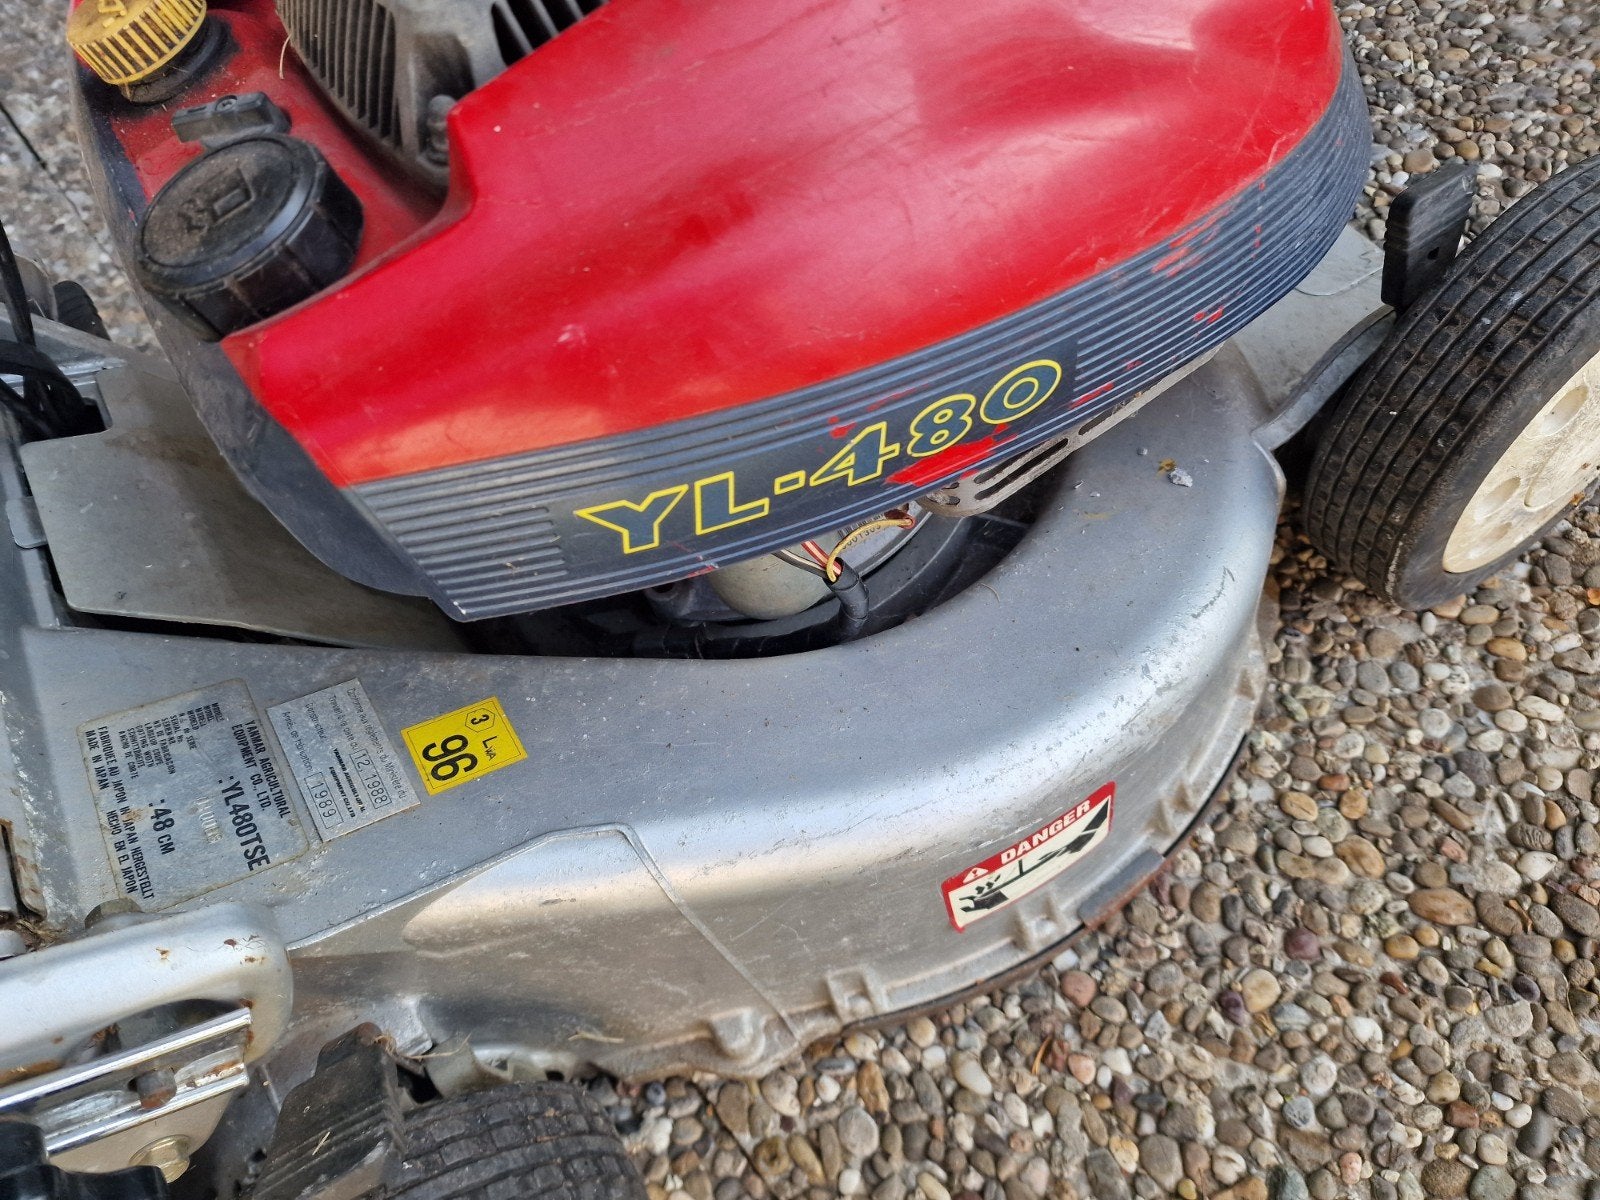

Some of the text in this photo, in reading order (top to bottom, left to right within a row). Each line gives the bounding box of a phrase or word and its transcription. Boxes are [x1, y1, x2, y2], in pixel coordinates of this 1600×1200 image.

[573, 359, 1062, 554] YL-480
[470, 713, 490, 725] 3
[230, 723, 257, 769] EQUIPMENT
[256, 790, 272, 811] LTD.
[244, 719, 291, 818] YANMAR AGRICULTURAL
[363, 773, 389, 804] 1988
[418, 731, 480, 784] 96
[83, 729, 139, 893] MADE IN JAPAN HECHO EN EL JAPON
[95, 726, 157, 901] FABRIQUEE AU JAPON IN JAPAN HERGESTELLT
[310, 782, 337, 818] 1989
[1000, 799, 1091, 864] DANGER
[156, 833, 175, 855] CM
